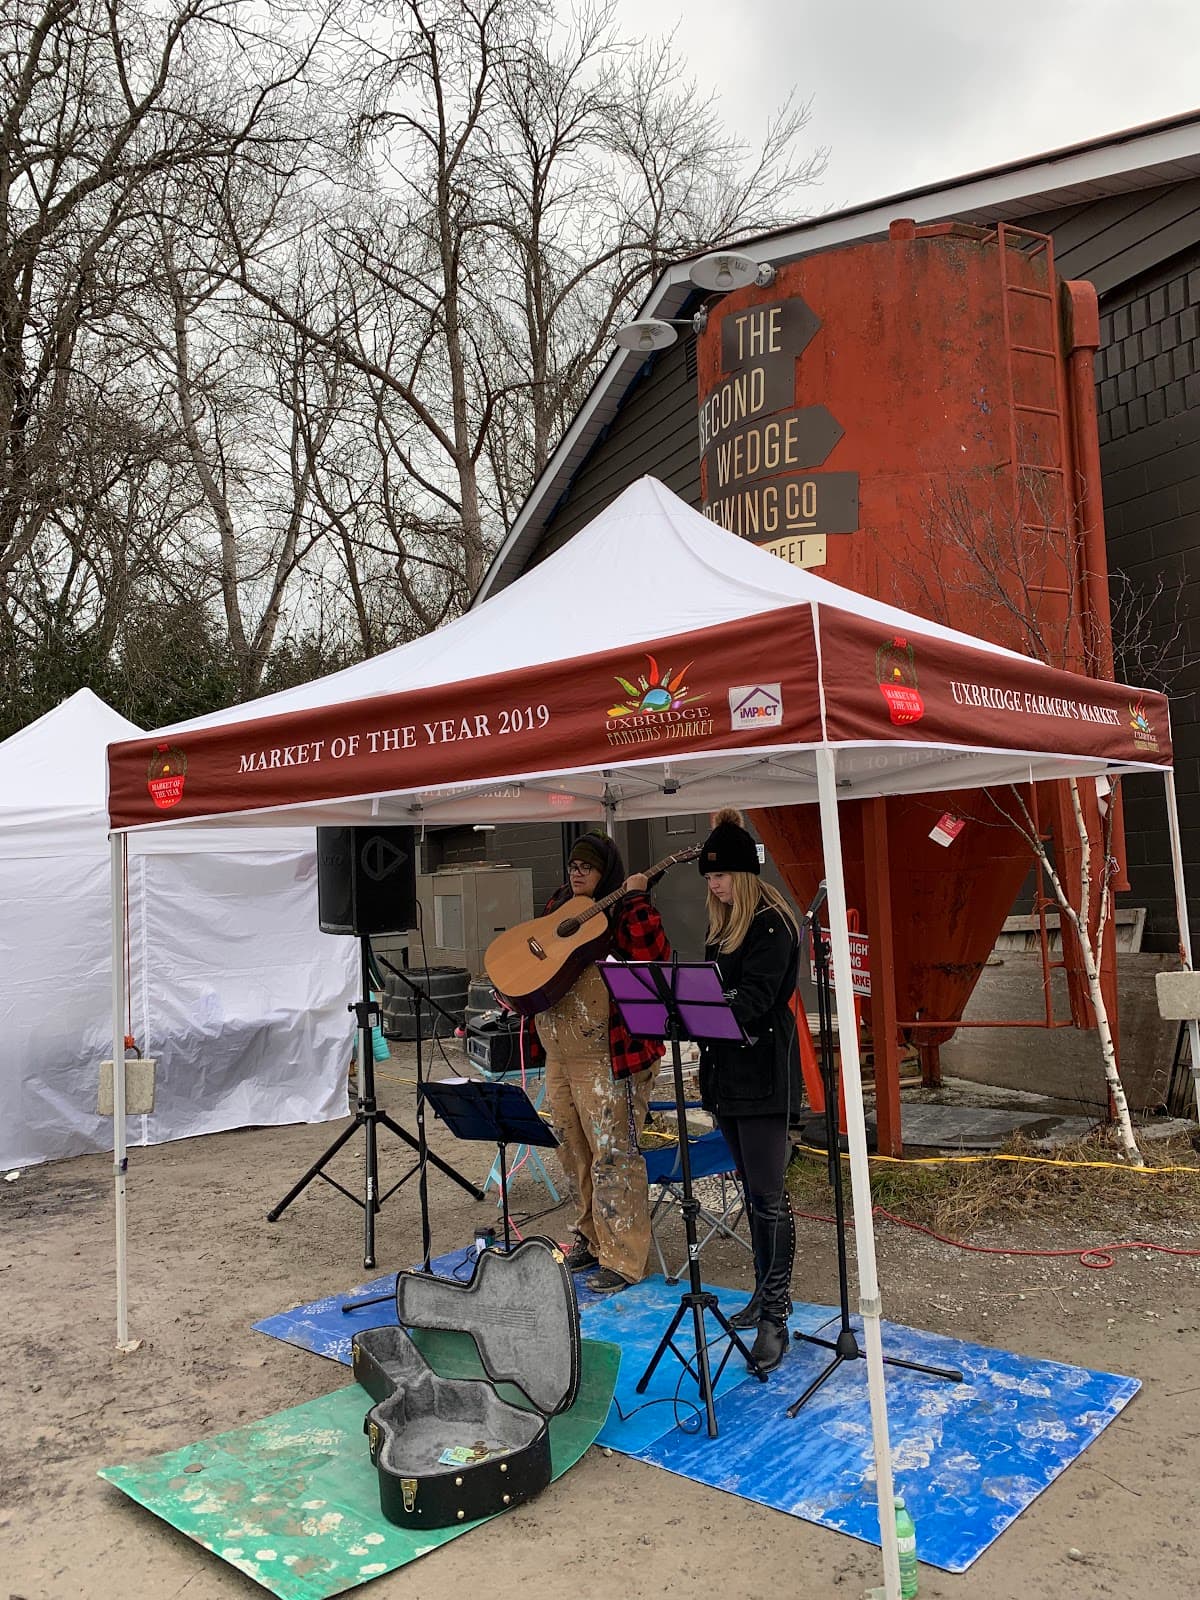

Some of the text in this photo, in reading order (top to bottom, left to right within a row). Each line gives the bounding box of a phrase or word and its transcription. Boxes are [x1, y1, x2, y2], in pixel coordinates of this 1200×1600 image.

[736, 307, 782, 360] THE
[699, 367, 765, 451] SECOND
[717, 417, 799, 488] WEDGE
[702, 481, 817, 536] EWING CO
[605, 706, 711, 731] UXBRIDGE
[665, 719, 714, 739] MARKET
[950, 681, 1121, 726] UXBRIDGE FARMER'S MARKET
[237, 704, 550, 774] MARKET OF THE YEAR 2019
